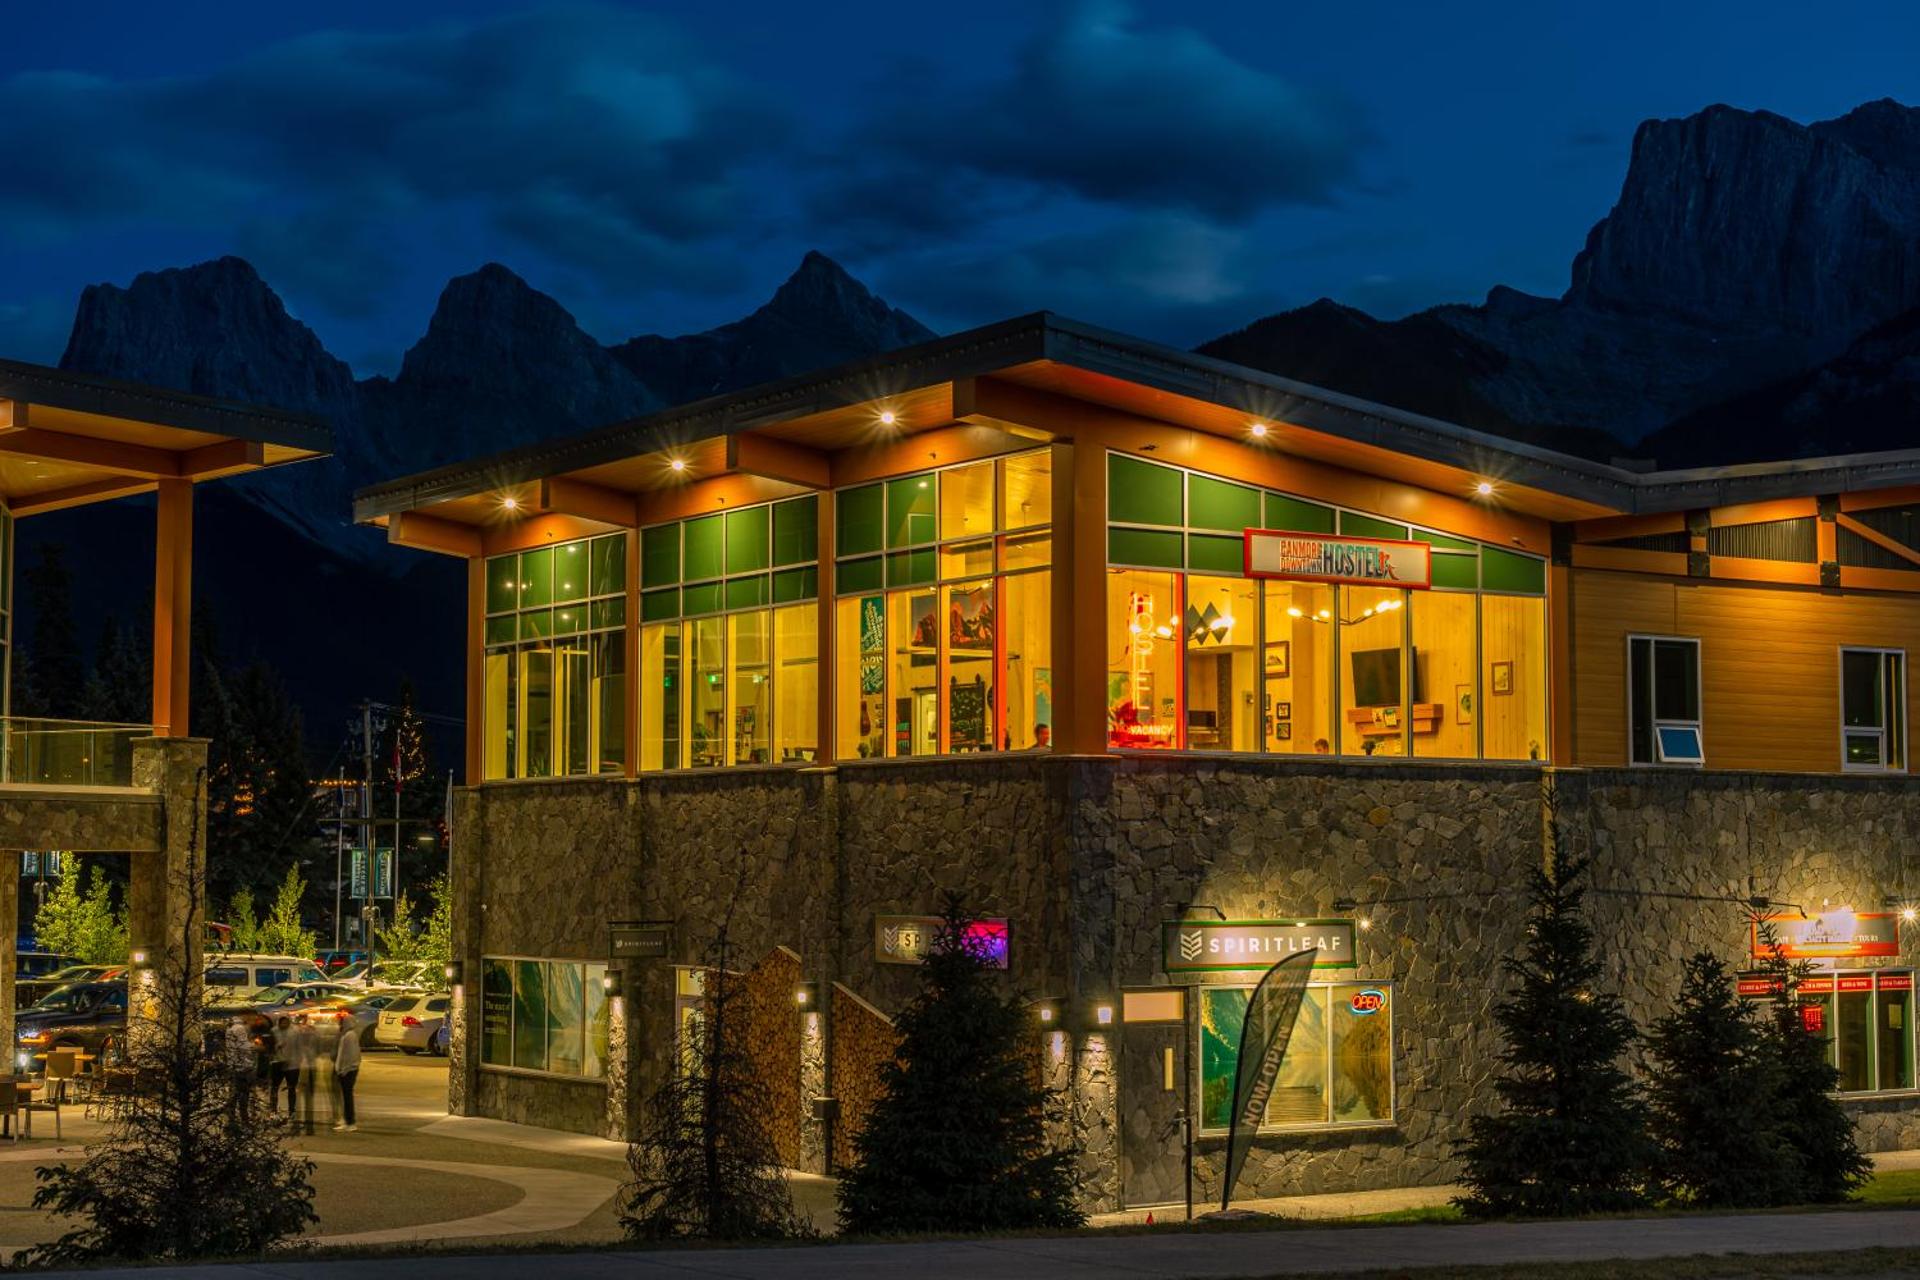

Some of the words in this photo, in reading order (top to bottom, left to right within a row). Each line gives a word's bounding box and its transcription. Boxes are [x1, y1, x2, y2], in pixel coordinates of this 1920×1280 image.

[1280, 539, 1322, 560] CANMORE
[1280, 557, 1322, 573] DOWNTOWN
[1323, 543, 1384, 577] HOSTEL
[1133, 592, 1153, 710] HOSTEL
[1130, 725, 1174, 736] VACANCY
[1208, 936, 1341, 953] SPIRITLEAF
[1352, 995, 1382, 1009] OPEN
[1241, 1079, 1270, 1128] NOW
[1262, 1025, 1291, 1078] OPEN
